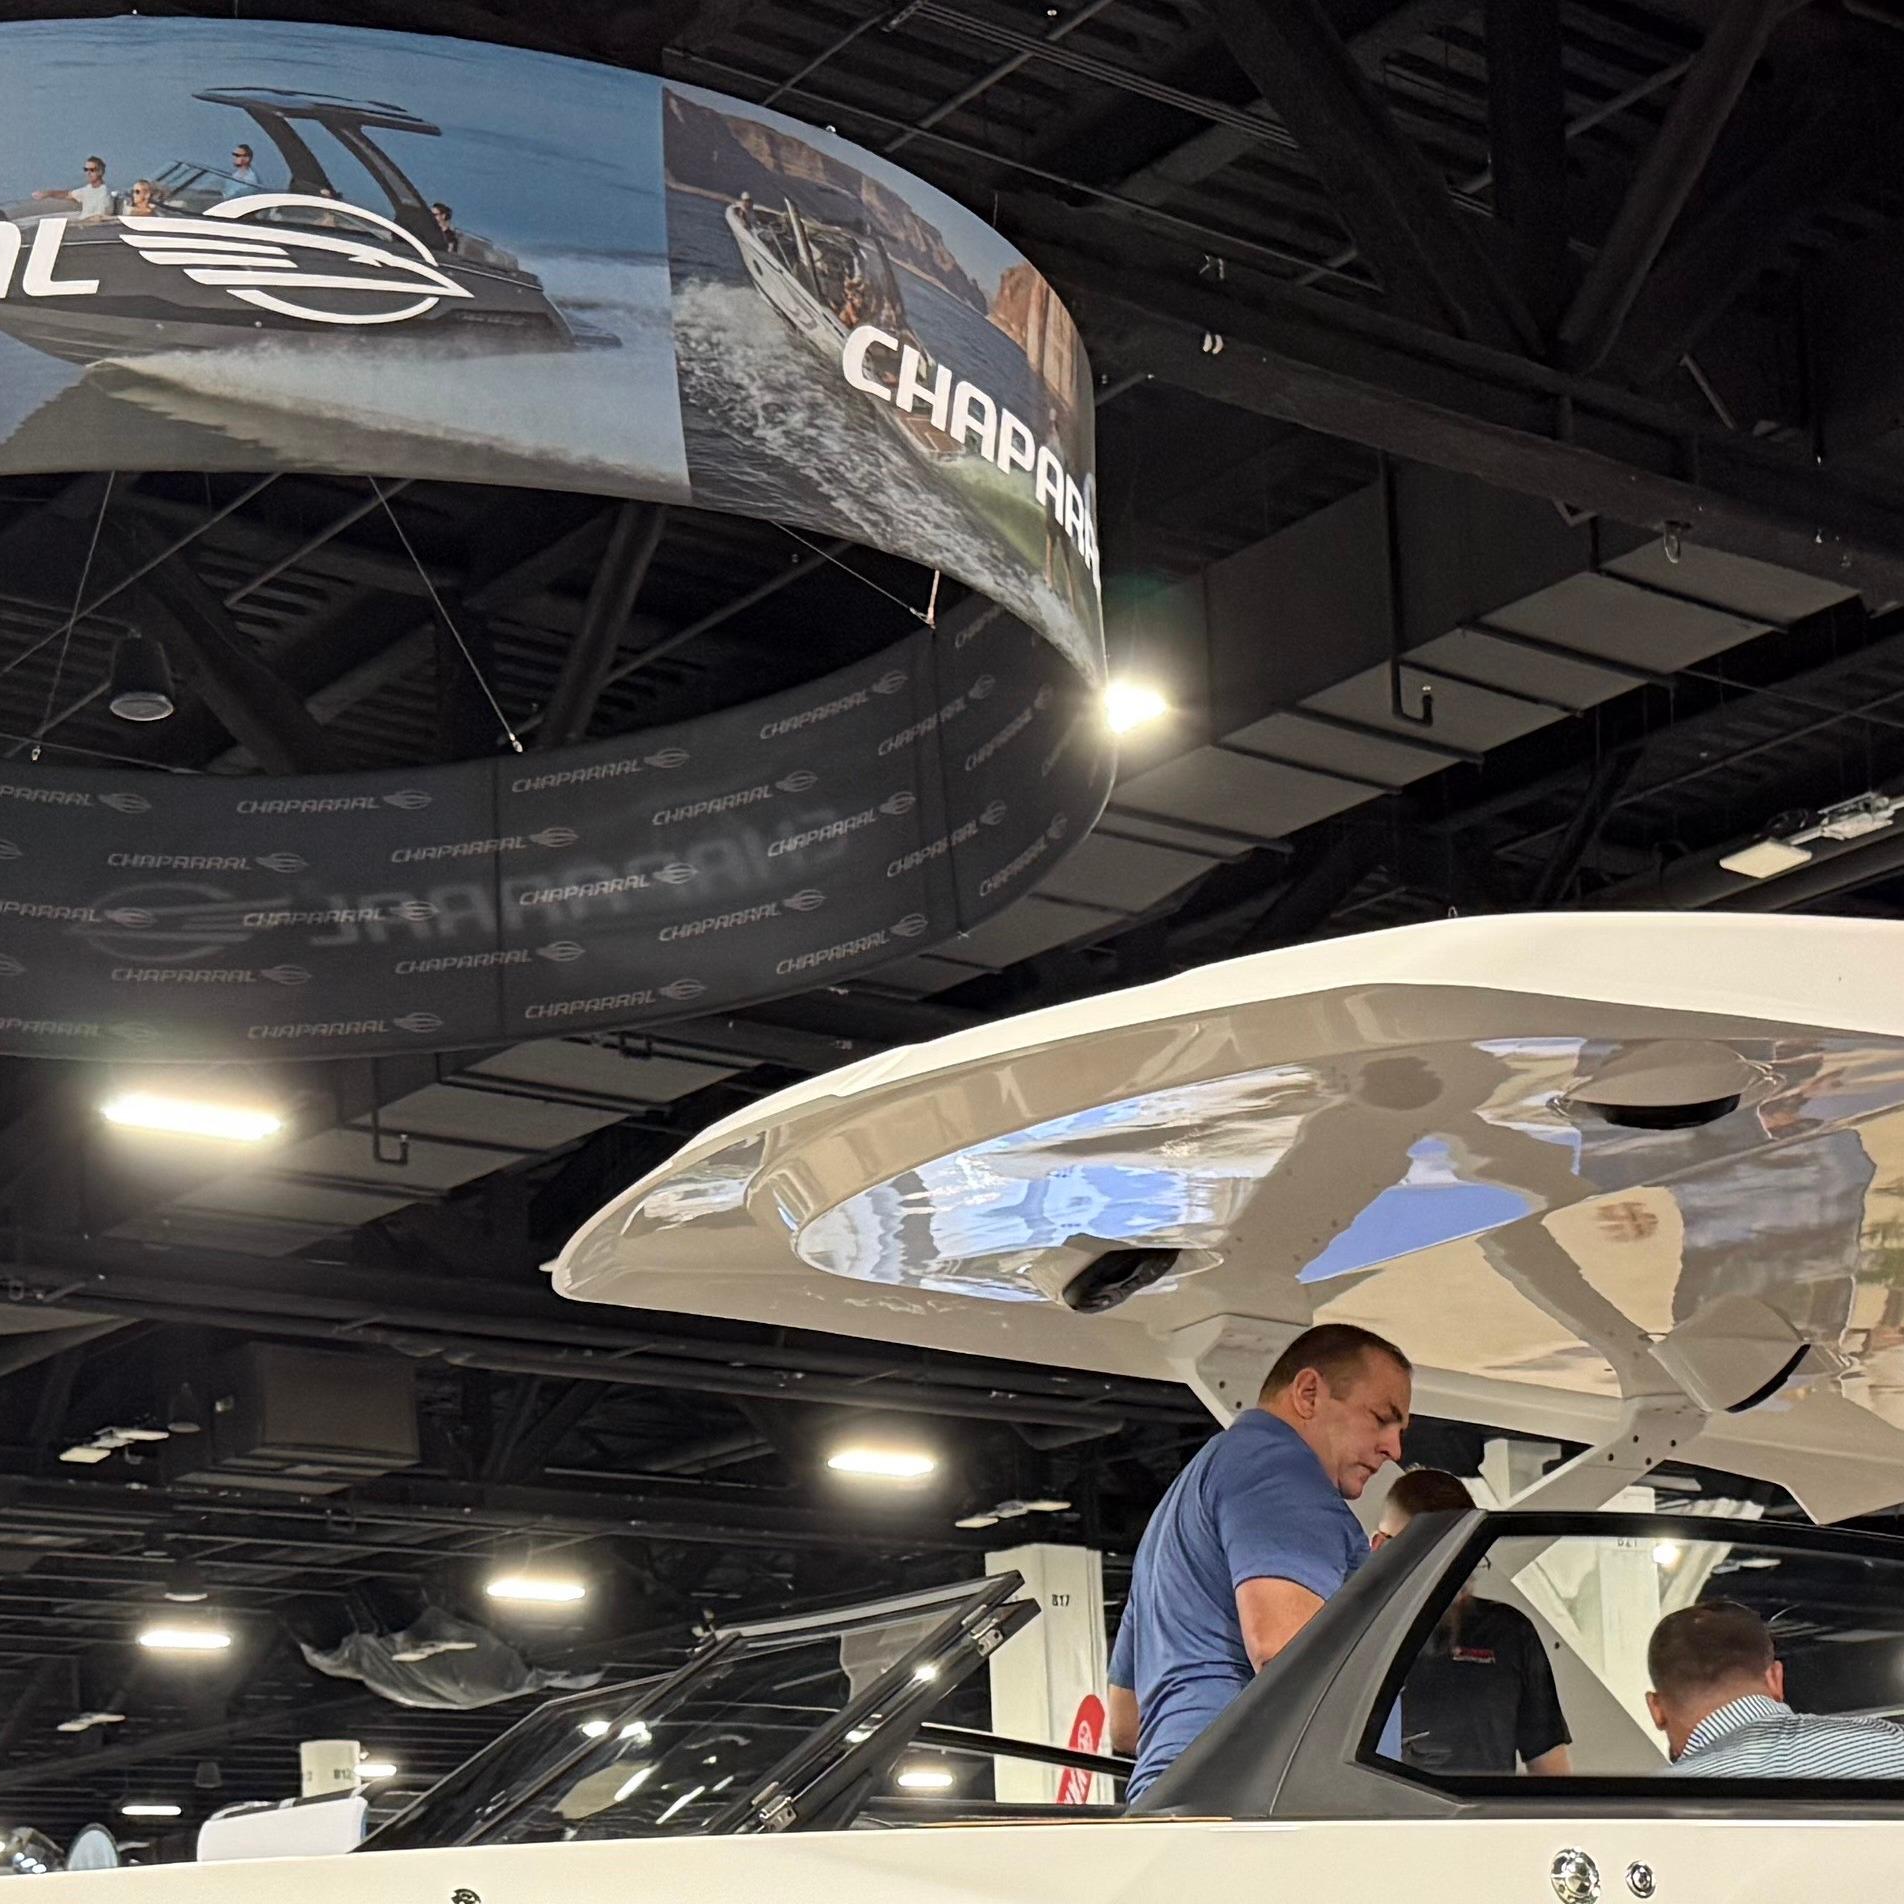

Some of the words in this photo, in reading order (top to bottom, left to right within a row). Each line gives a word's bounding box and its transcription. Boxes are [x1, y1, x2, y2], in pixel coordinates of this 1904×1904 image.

[760, 690, 869, 741] CHAPARRAL
[511, 759, 644, 794] CHAPARRAL
[236, 796, 381, 815] CHAPARRAL
[652, 786, 773, 827] CHAPARRAL
[768, 809, 878, 858] CHAPARRAL
[108, 851, 252, 871] CHAPARRAL
[391, 835, 527, 864] CHAPARRAL
[519, 874, 650, 907] CHAPARRAL
[244, 908, 386, 928] CHAPARRAL
[659, 902, 782, 943] CHAPARRAL
[395, 947, 532, 975] CHAPARRAL
[776, 931, 891, 976] CHAPARRAL
[112, 966, 257, 984] CHAPARRAL
[525, 990, 657, 1020] CHAPARRAL
[248, 1020, 389, 1041] CHAPARRAL
